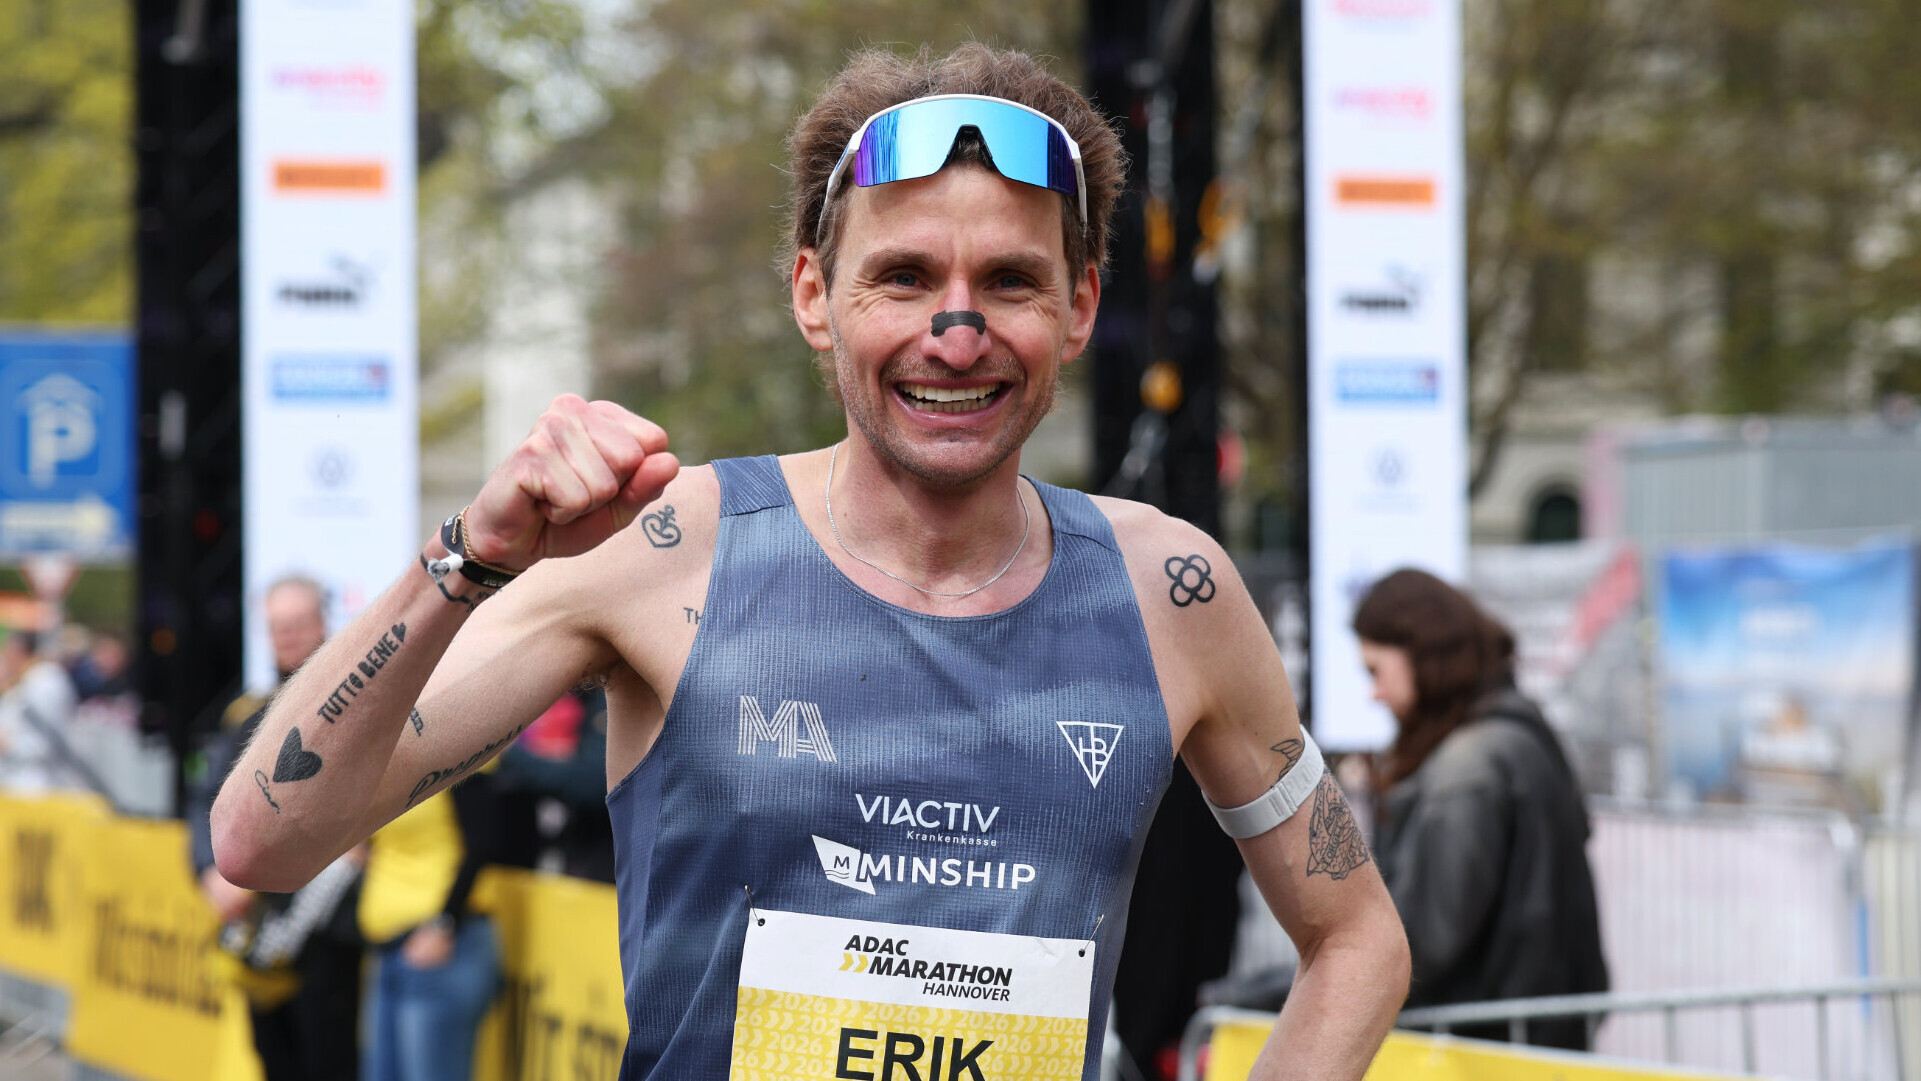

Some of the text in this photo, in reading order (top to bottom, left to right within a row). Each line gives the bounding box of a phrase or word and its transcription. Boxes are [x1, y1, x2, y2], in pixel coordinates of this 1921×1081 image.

[317, 632, 399, 724] TUTTO BENE
[855, 793, 1000, 833] VIACTIV
[906, 831, 997, 847] Krankenkasse
[859, 853, 1036, 889] MINSHIP
[844, 934, 910, 956] ADAC
[868, 956, 1012, 987] MARATHON
[922, 982, 1010, 1001] HANNOVER
[769, 990, 1087, 1036] 2026 2026 2026 2026
[797, 1014, 852, 1037] 202
[766, 1031, 823, 1056] 2026
[1036, 1055, 1082, 1077] 2026
[792, 1055, 836, 1078] 202
[836, 1027, 995, 1081] ERIK
